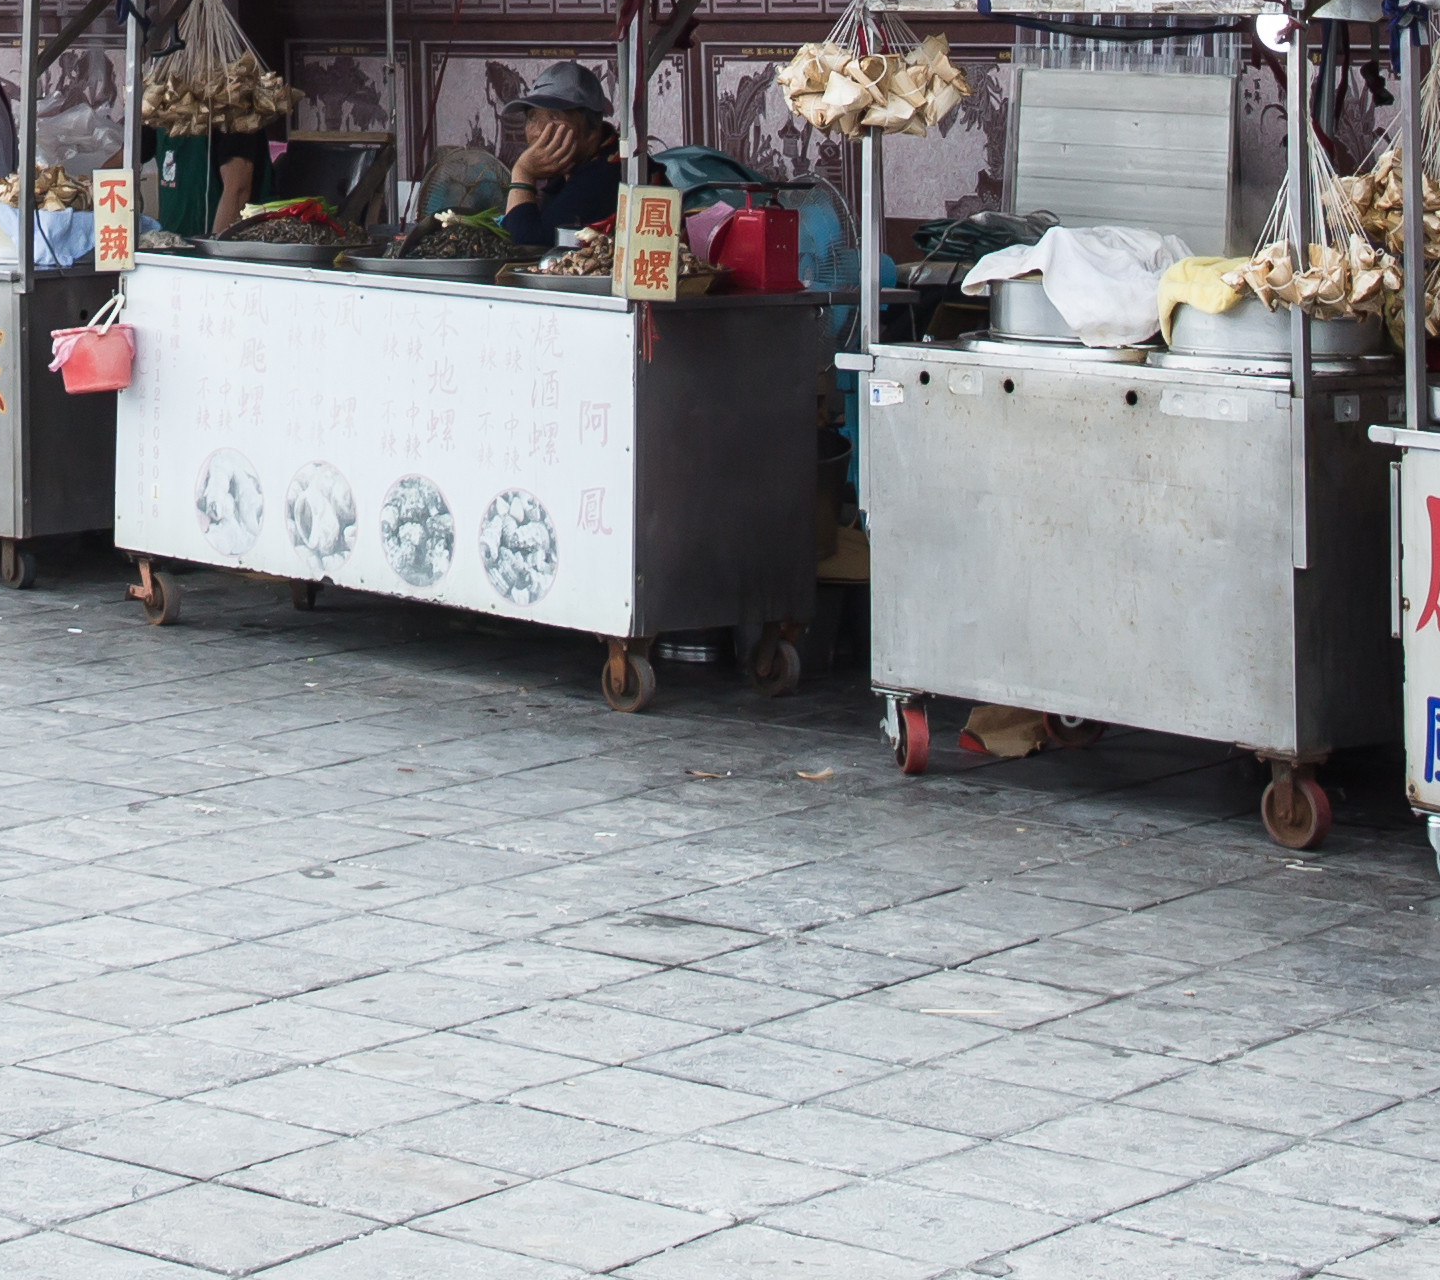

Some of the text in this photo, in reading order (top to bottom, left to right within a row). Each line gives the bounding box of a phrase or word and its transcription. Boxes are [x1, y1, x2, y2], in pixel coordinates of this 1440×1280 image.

[98, 179, 129, 261] 不辣
[634, 197, 673, 291] 鳳螺
[237, 283, 269, 427] 風颱螺
[426, 301, 459, 453] 本地螺
[528, 311, 564, 466] 燒酒螺
[578, 399, 614, 536] 阿鳳
